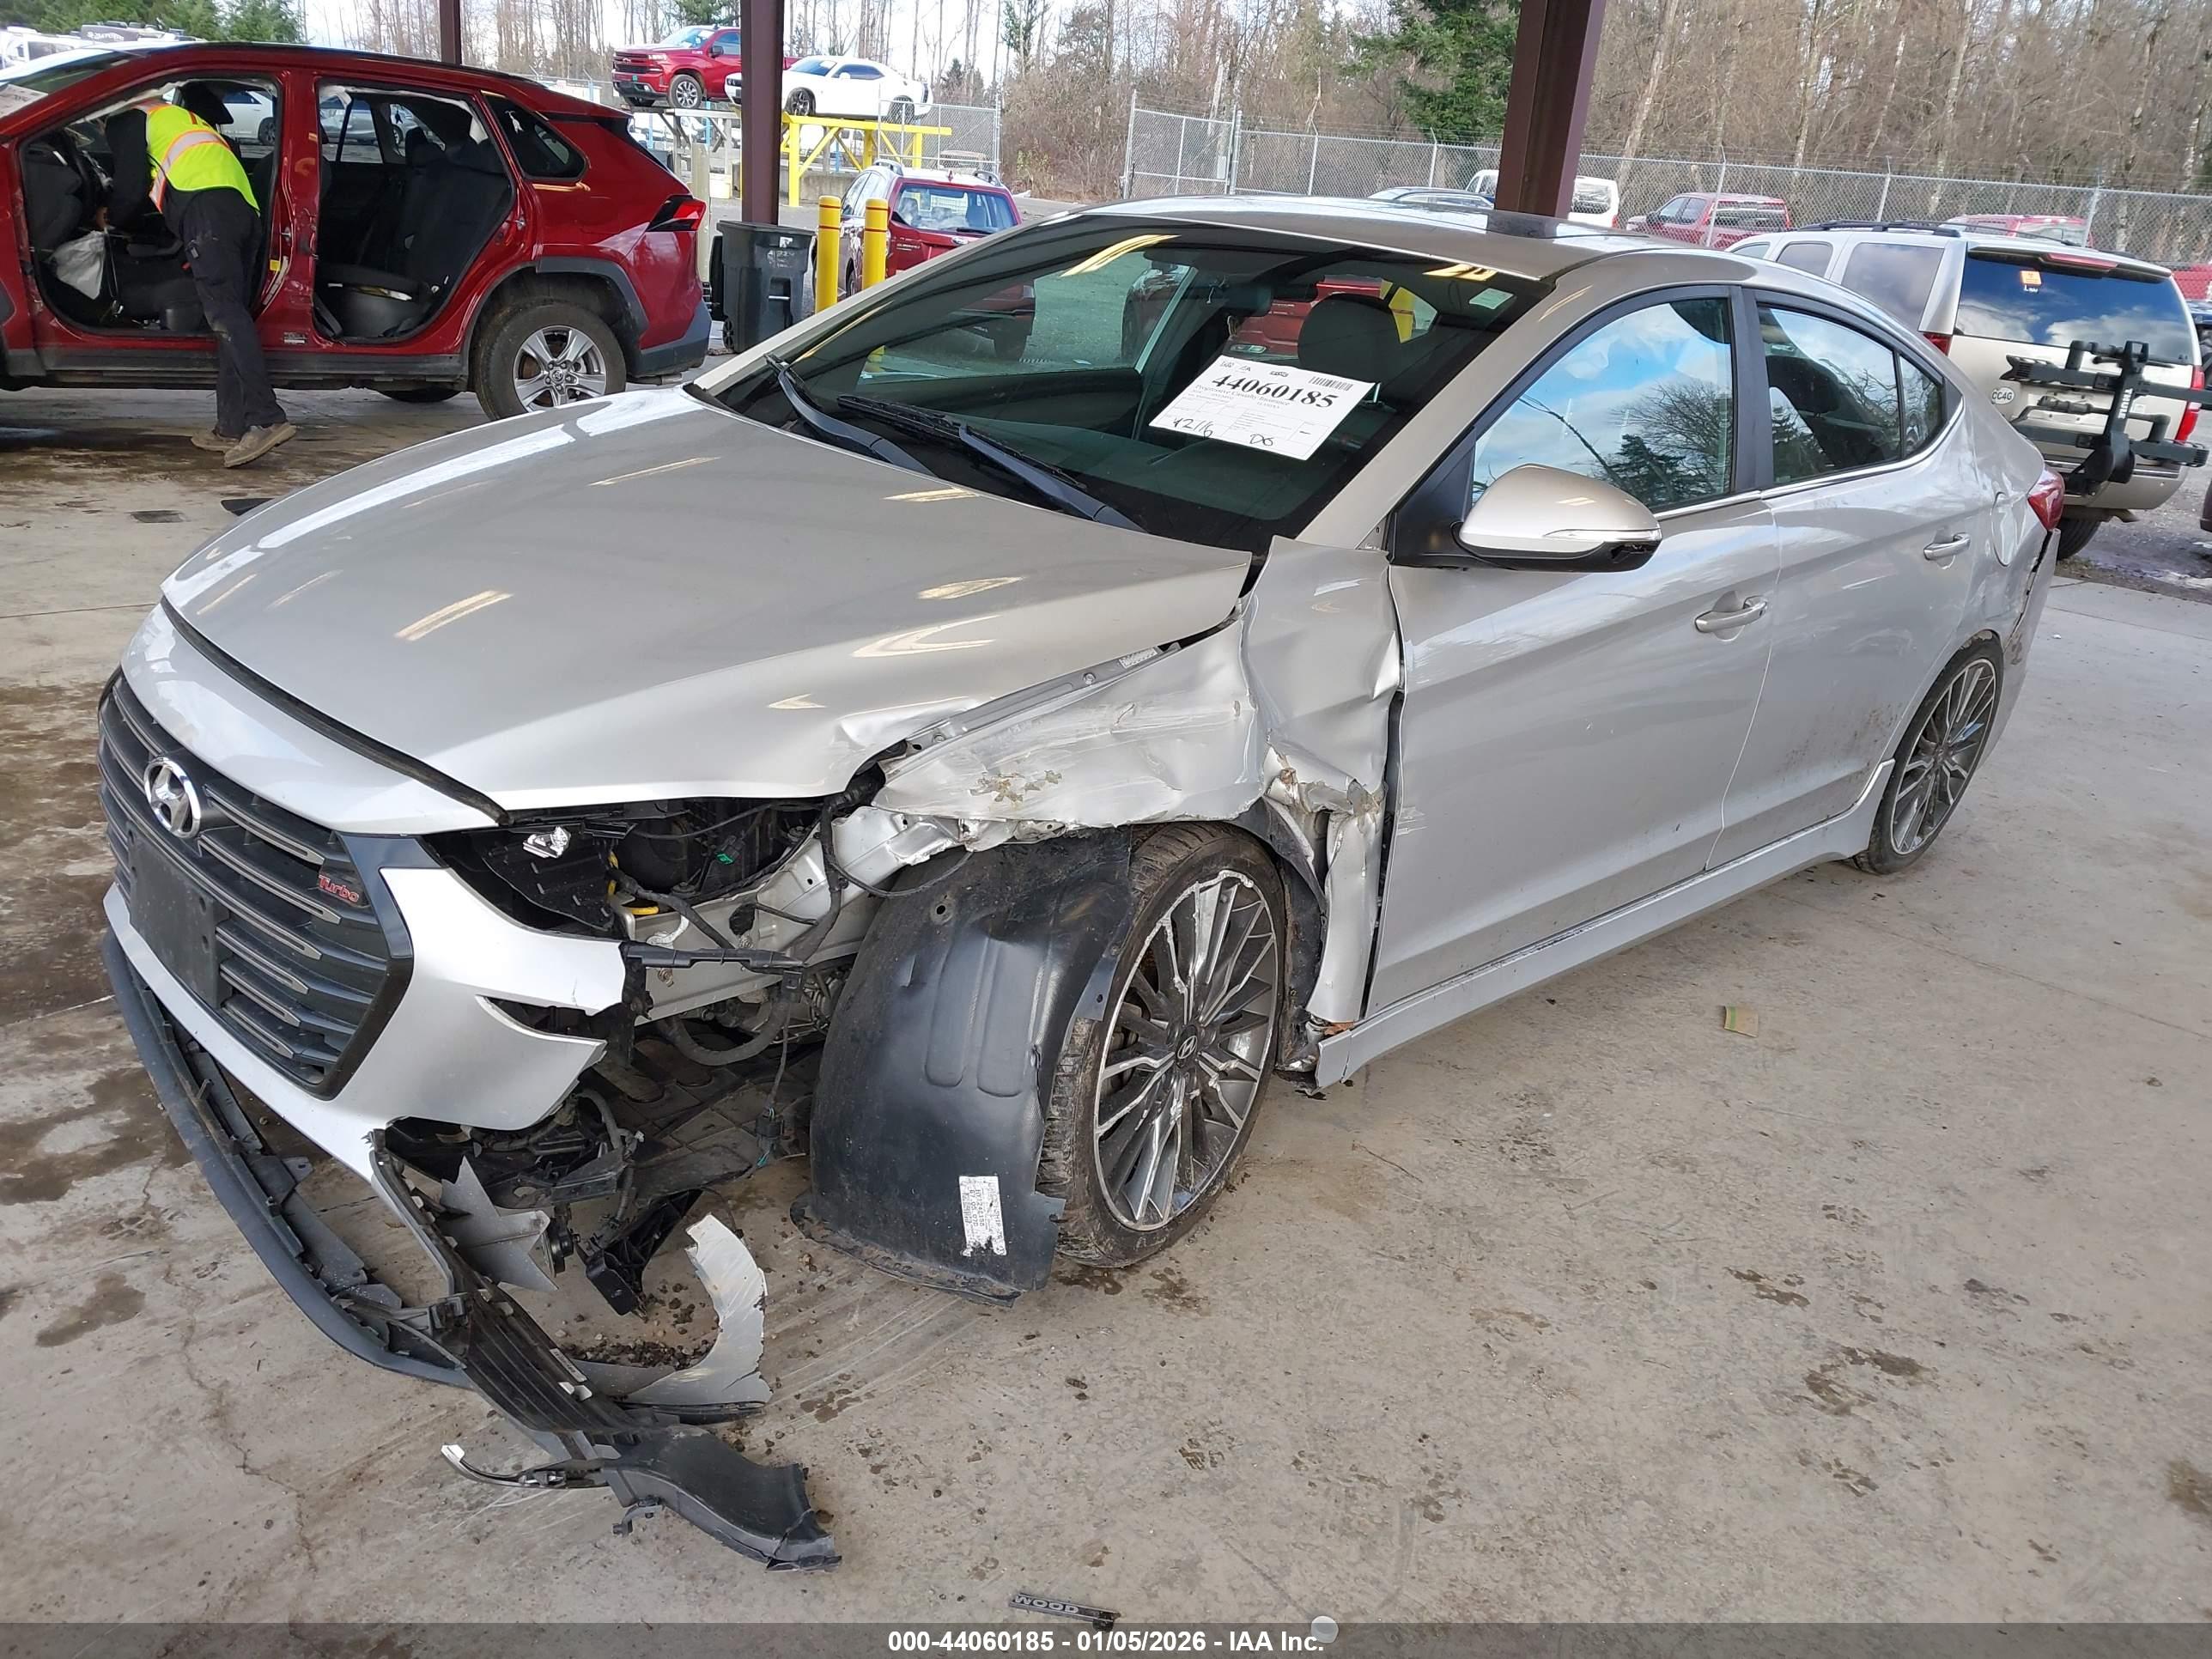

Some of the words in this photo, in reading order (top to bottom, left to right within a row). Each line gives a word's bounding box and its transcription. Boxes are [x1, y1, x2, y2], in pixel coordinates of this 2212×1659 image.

[1212, 374, 1340, 408] 44060185
[2118, 388, 2134, 419] THULE
[319, 874, 360, 902] Turbo
[1015, 1595, 1079, 1613] WOOD
